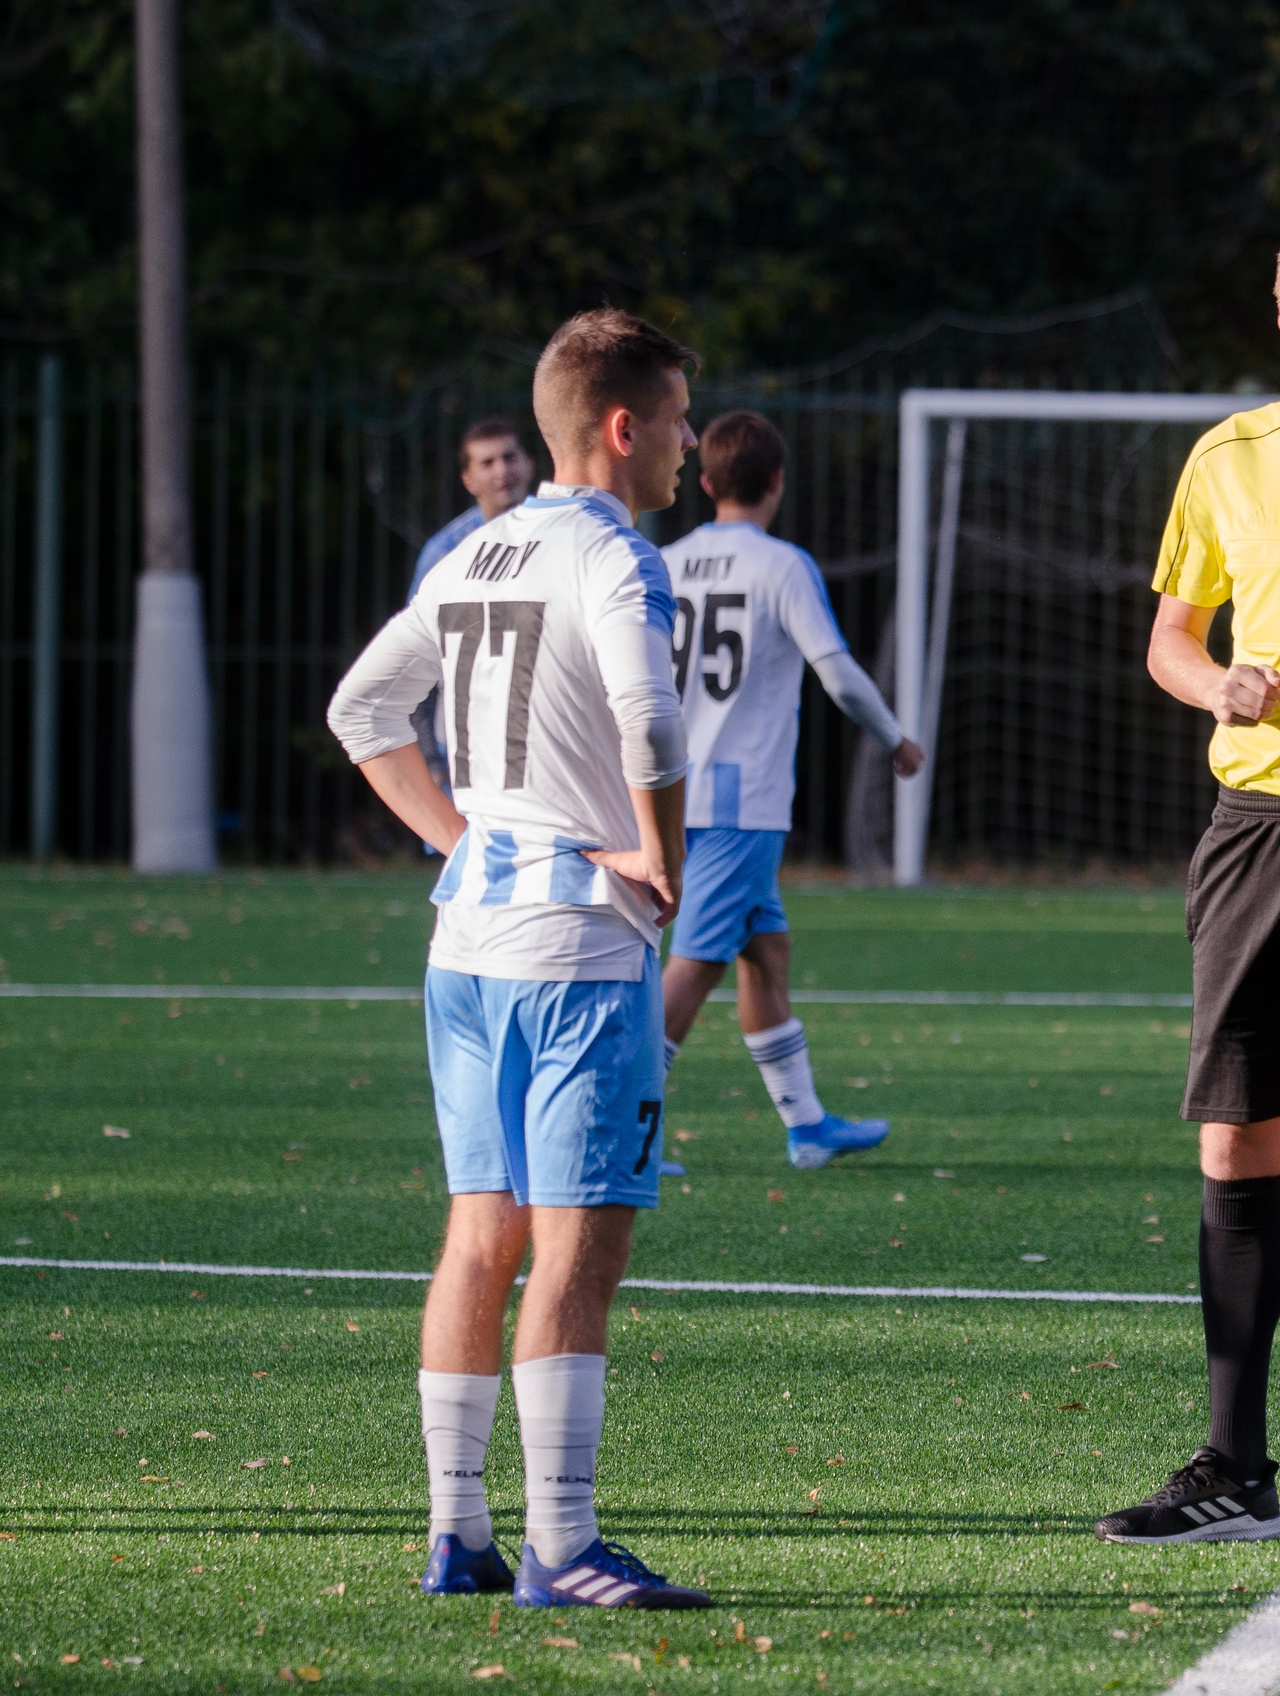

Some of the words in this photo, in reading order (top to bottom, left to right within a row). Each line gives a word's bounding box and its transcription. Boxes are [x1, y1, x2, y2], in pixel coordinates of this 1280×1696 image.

[438, 602, 546, 790] 77
[671, 593, 746, 704] 95
[633, 1101, 661, 1175] 7
